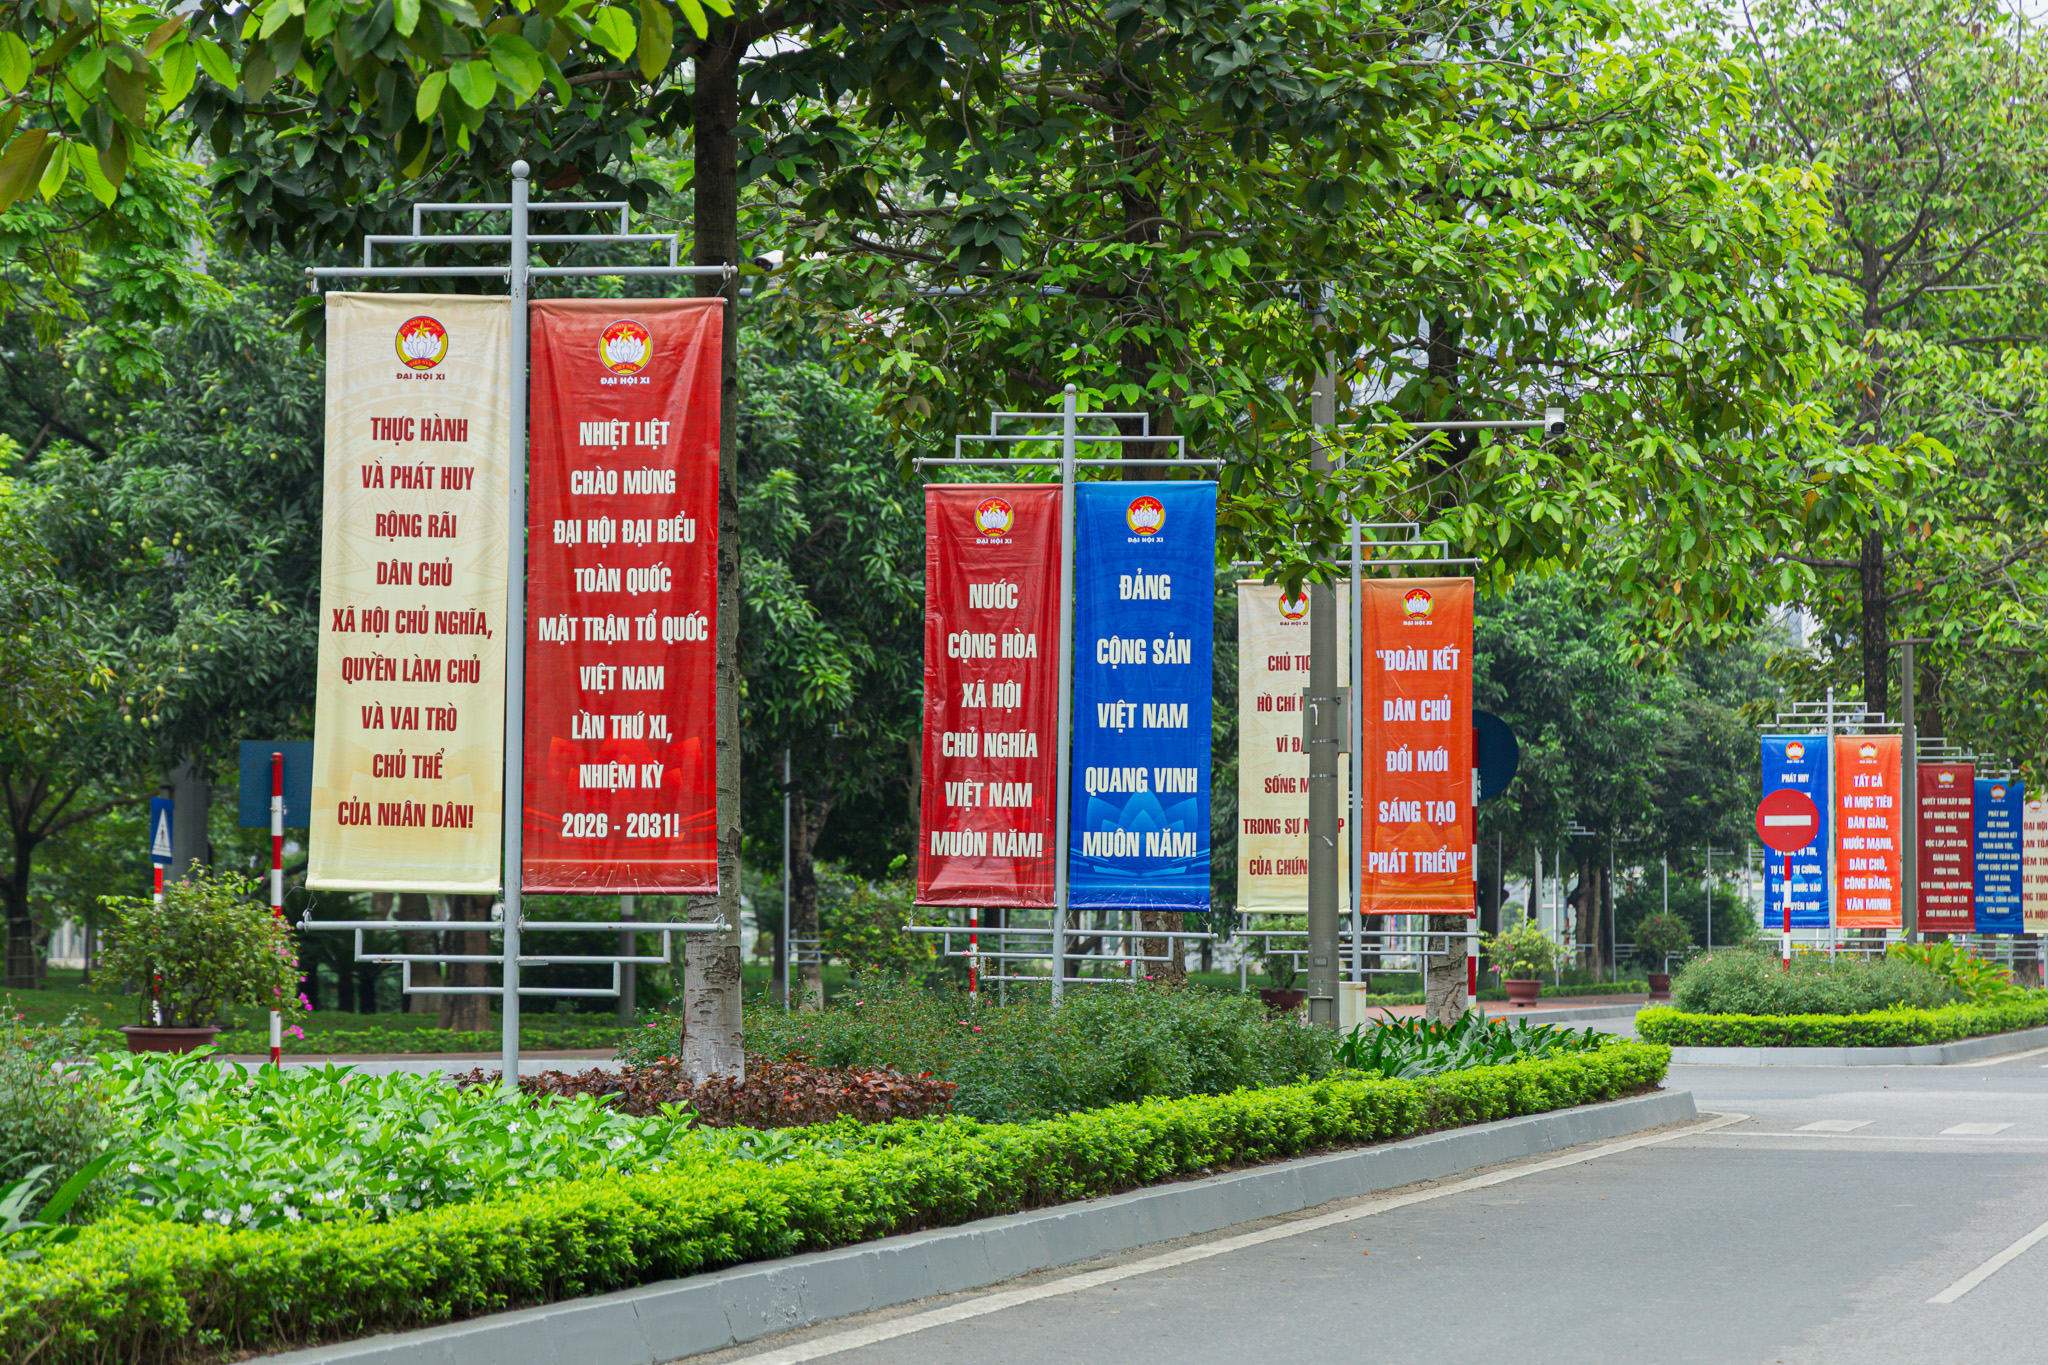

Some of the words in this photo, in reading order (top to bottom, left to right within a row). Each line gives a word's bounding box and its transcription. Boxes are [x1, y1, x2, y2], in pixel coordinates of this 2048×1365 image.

[416, 373, 432, 381] HỘI
[600, 377, 617, 386] ĐẠI
[620, 376, 637, 386] HỘI
[370, 416, 414, 446] THỰC
[421, 414, 468, 442] HÀNH
[580, 418, 630, 450] NHIỆT
[635, 418, 670, 450] LIỆT
[362, 457, 384, 488] VÀ
[390, 462, 435, 489] PHÁT
[441, 467, 474, 490] HUY
[571, 466, 617, 494] CHÀO
[624, 466, 675, 494] MỪNG
[376, 510, 422, 542] RỘNG
[428, 511, 456, 538] RÃI
[553, 520, 581, 547] ĐẠI
[588, 516, 616, 548] HỘI
[622, 519, 652, 547] ĐẠI
[657, 511, 695, 542] BIỂU
[377, 559, 412, 585] DÂN
[419, 557, 452, 586] CHỦ
[574, 564, 620, 592] TOÀN
[627, 562, 671, 596] QUỐC
[1119, 568, 1170, 600] ĐẢNG
[970, 579, 1018, 609] NƯỚC
[332, 606, 355, 632] XÃ
[362, 606, 389, 638] HỘI
[396, 605, 428, 634] CHỦ
[435, 608, 492, 639] NGHĨA,
[539, 614, 578, 645] MẶT
[583, 614, 629, 644] TRẬN
[635, 609, 656, 641] TỔ
[662, 611, 708, 644] QUỐC
[948, 630, 996, 663] CỘNG
[1002, 628, 1037, 658] HÒA
[1097, 636, 1146, 669] CỘNG
[1153, 632, 1190, 664] SẢN
[1432, 644, 1460, 670] KẾT
[342, 652, 396, 684] QUYỀN
[403, 654, 440, 682] LÀM
[447, 654, 480, 683] CHỦ
[1268, 652, 1290, 671] CHỦ
[1295, 655, 1309, 673] TỊC
[580, 663, 617, 694] VIỆT
[622, 666, 664, 690] NAM
[962, 680, 986, 707] XÃ
[992, 680, 1021, 713] HỘI
[1257, 692, 1272, 712] HỒ
[1277, 693, 1296, 712] CHÍ
[1384, 697, 1416, 721] DÂN
[1420, 694, 1451, 721] CHỦ
[362, 701, 384, 729] VÀ
[391, 706, 419, 730] VAI
[425, 702, 457, 731] TRÒ
[572, 710, 604, 739] LẦN
[610, 711, 645, 739] THỨ
[649, 715, 672, 743] XI,
[1098, 700, 1137, 733] VIỆT
[1143, 704, 1188, 728] NAM
[943, 726, 978, 758] CHỦ
[984, 729, 1038, 758] NGHĨA
[1277, 735, 1288, 752] VĨ
[373, 749, 406, 778] CHỦ
[412, 748, 444, 779] THỂ
[1386, 744, 1412, 772] ĐỔI
[1417, 746, 1448, 772] MỚI
[580, 761, 635, 792] NHIỆM
[642, 760, 664, 788] KỲ
[1086, 767, 1148, 796] QUANG
[1154, 768, 1197, 792] VINH
[1265, 774, 1296, 793] SỐNG
[946, 778, 984, 811] VIỆT
[989, 783, 1032, 807] NAM
[338, 796, 371, 825] CỦA
[378, 800, 426, 826] NHÂN
[432, 801, 473, 828] DÂN!
[562, 813, 608, 837] 2026
[627, 813, 679, 838] 2031!
[1379, 797, 1421, 822] SÁNG
[1425, 801, 1456, 825] TẠO
[931, 828, 987, 856] MUÔN
[993, 829, 1042, 857] NĂM!
[1083, 828, 1139, 857] MUÔN
[1146, 828, 1196, 857] NĂM!
[1243, 819, 1280, 834] TRONG
[1285, 818, 1300, 837] SỰ
[1250, 856, 1272, 875] CỦA
[1277, 856, 1308, 875] CHÚN
[1368, 848, 1408, 873] PHÁT
